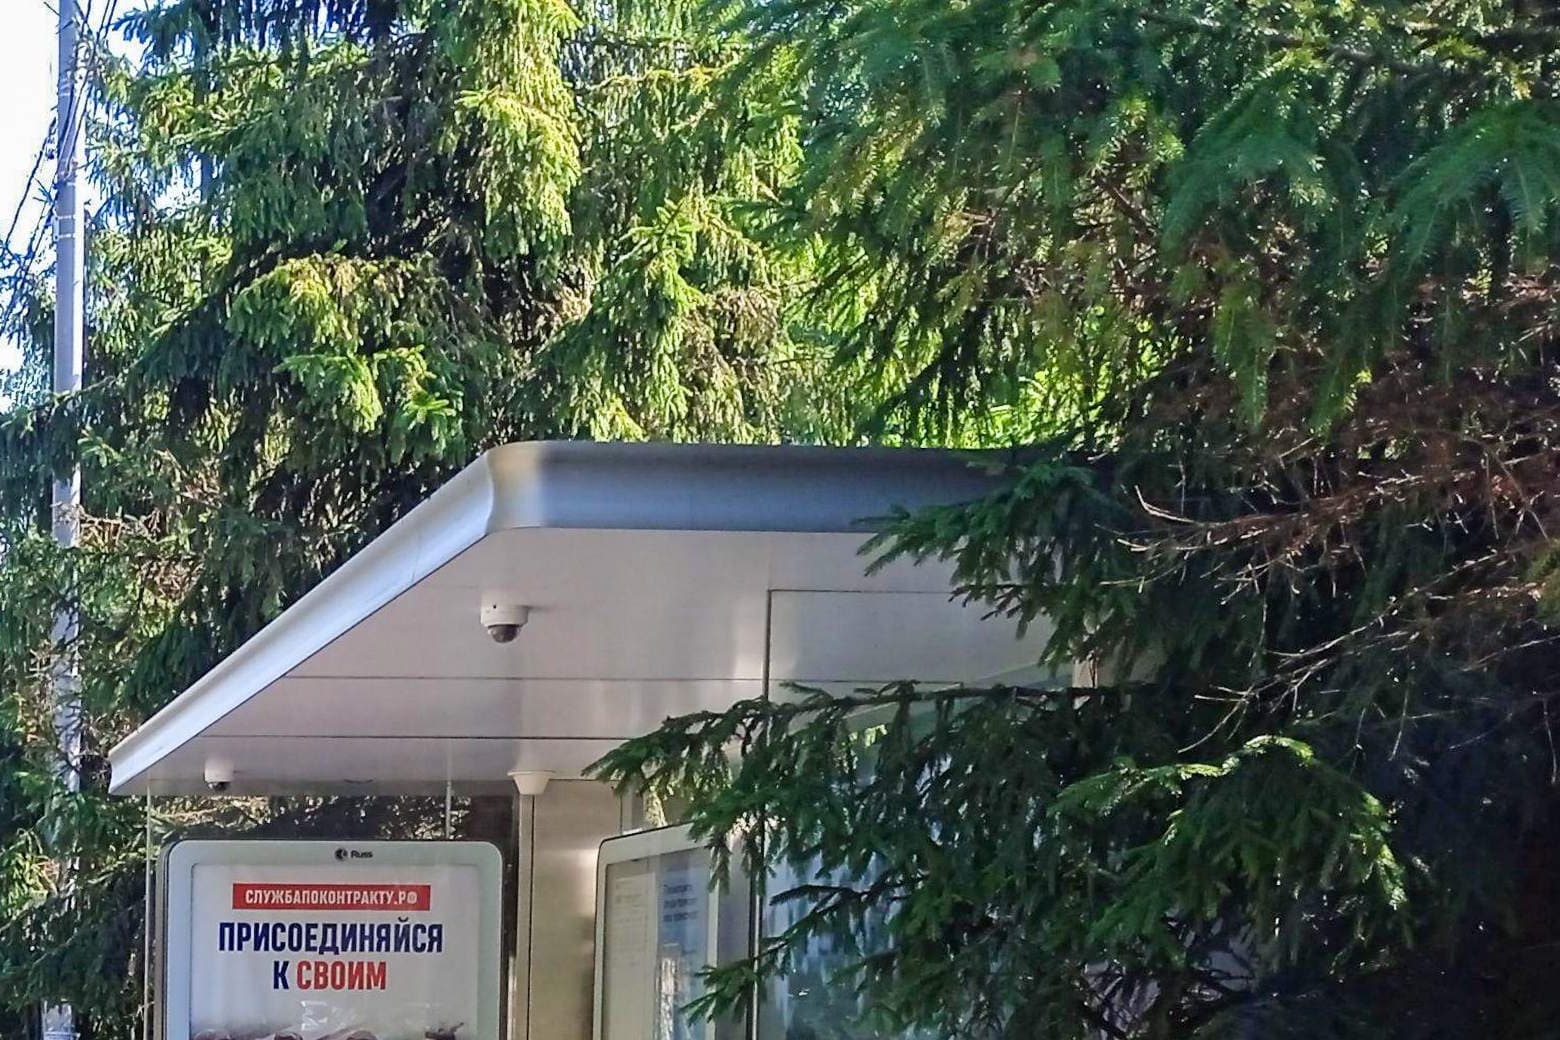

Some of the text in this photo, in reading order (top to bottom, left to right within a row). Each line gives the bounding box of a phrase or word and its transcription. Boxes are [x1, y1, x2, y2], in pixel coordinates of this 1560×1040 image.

[245, 888, 418, 906] СЛУЖБАПОКОНТРАКТУ.РФ
[219, 917, 443, 955] ПРИСОЕДИНЯЙСЯ
[273, 960, 387, 991] К СВОИМ
